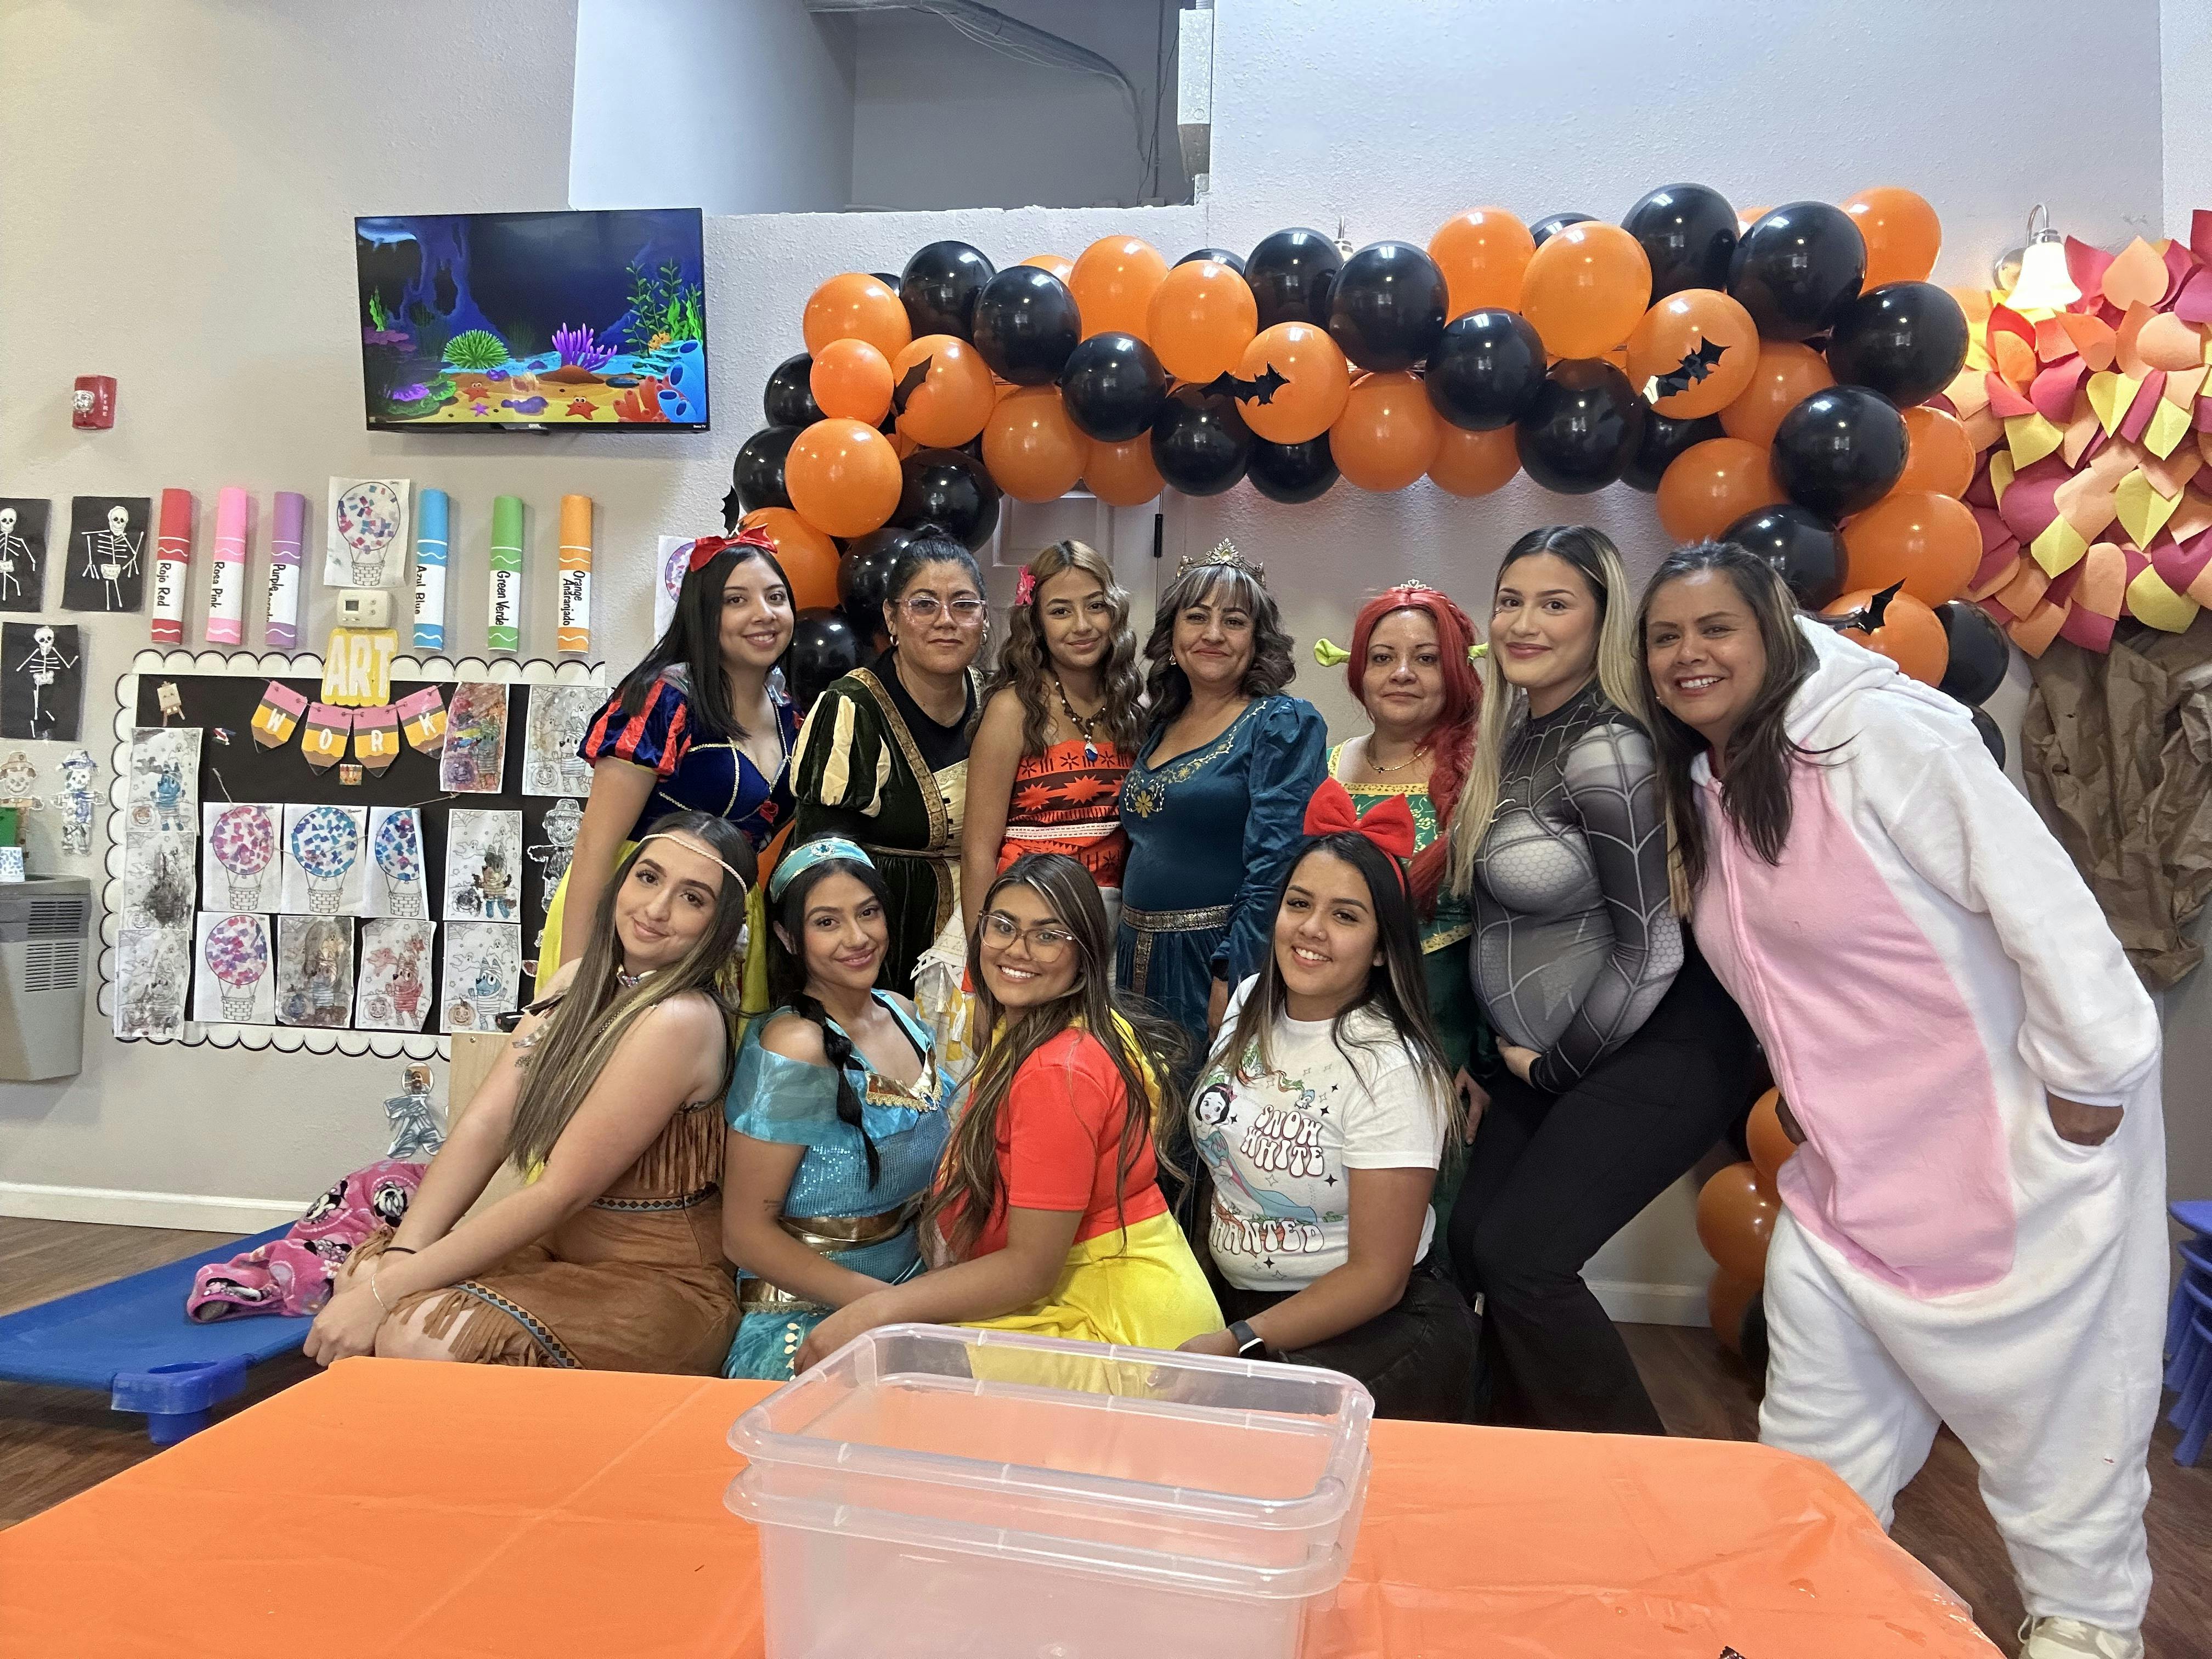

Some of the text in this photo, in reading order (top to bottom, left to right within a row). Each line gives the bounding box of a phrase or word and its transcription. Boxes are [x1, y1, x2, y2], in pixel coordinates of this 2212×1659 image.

[157, 563, 171, 606] Rojo Red
[211, 562, 224, 608] Rosa Pink
[269, 564, 286, 591] Purple
[416, 566, 427, 587] Azul
[495, 571, 511, 625] Green Verde
[569, 570, 585, 601] Orange
[561, 578, 575, 625] Anaranjado
[324, 635, 394, 698] ART
[1255, 1104, 1323, 1147] SNOW
[1240, 1126, 1324, 1177] WHITE
